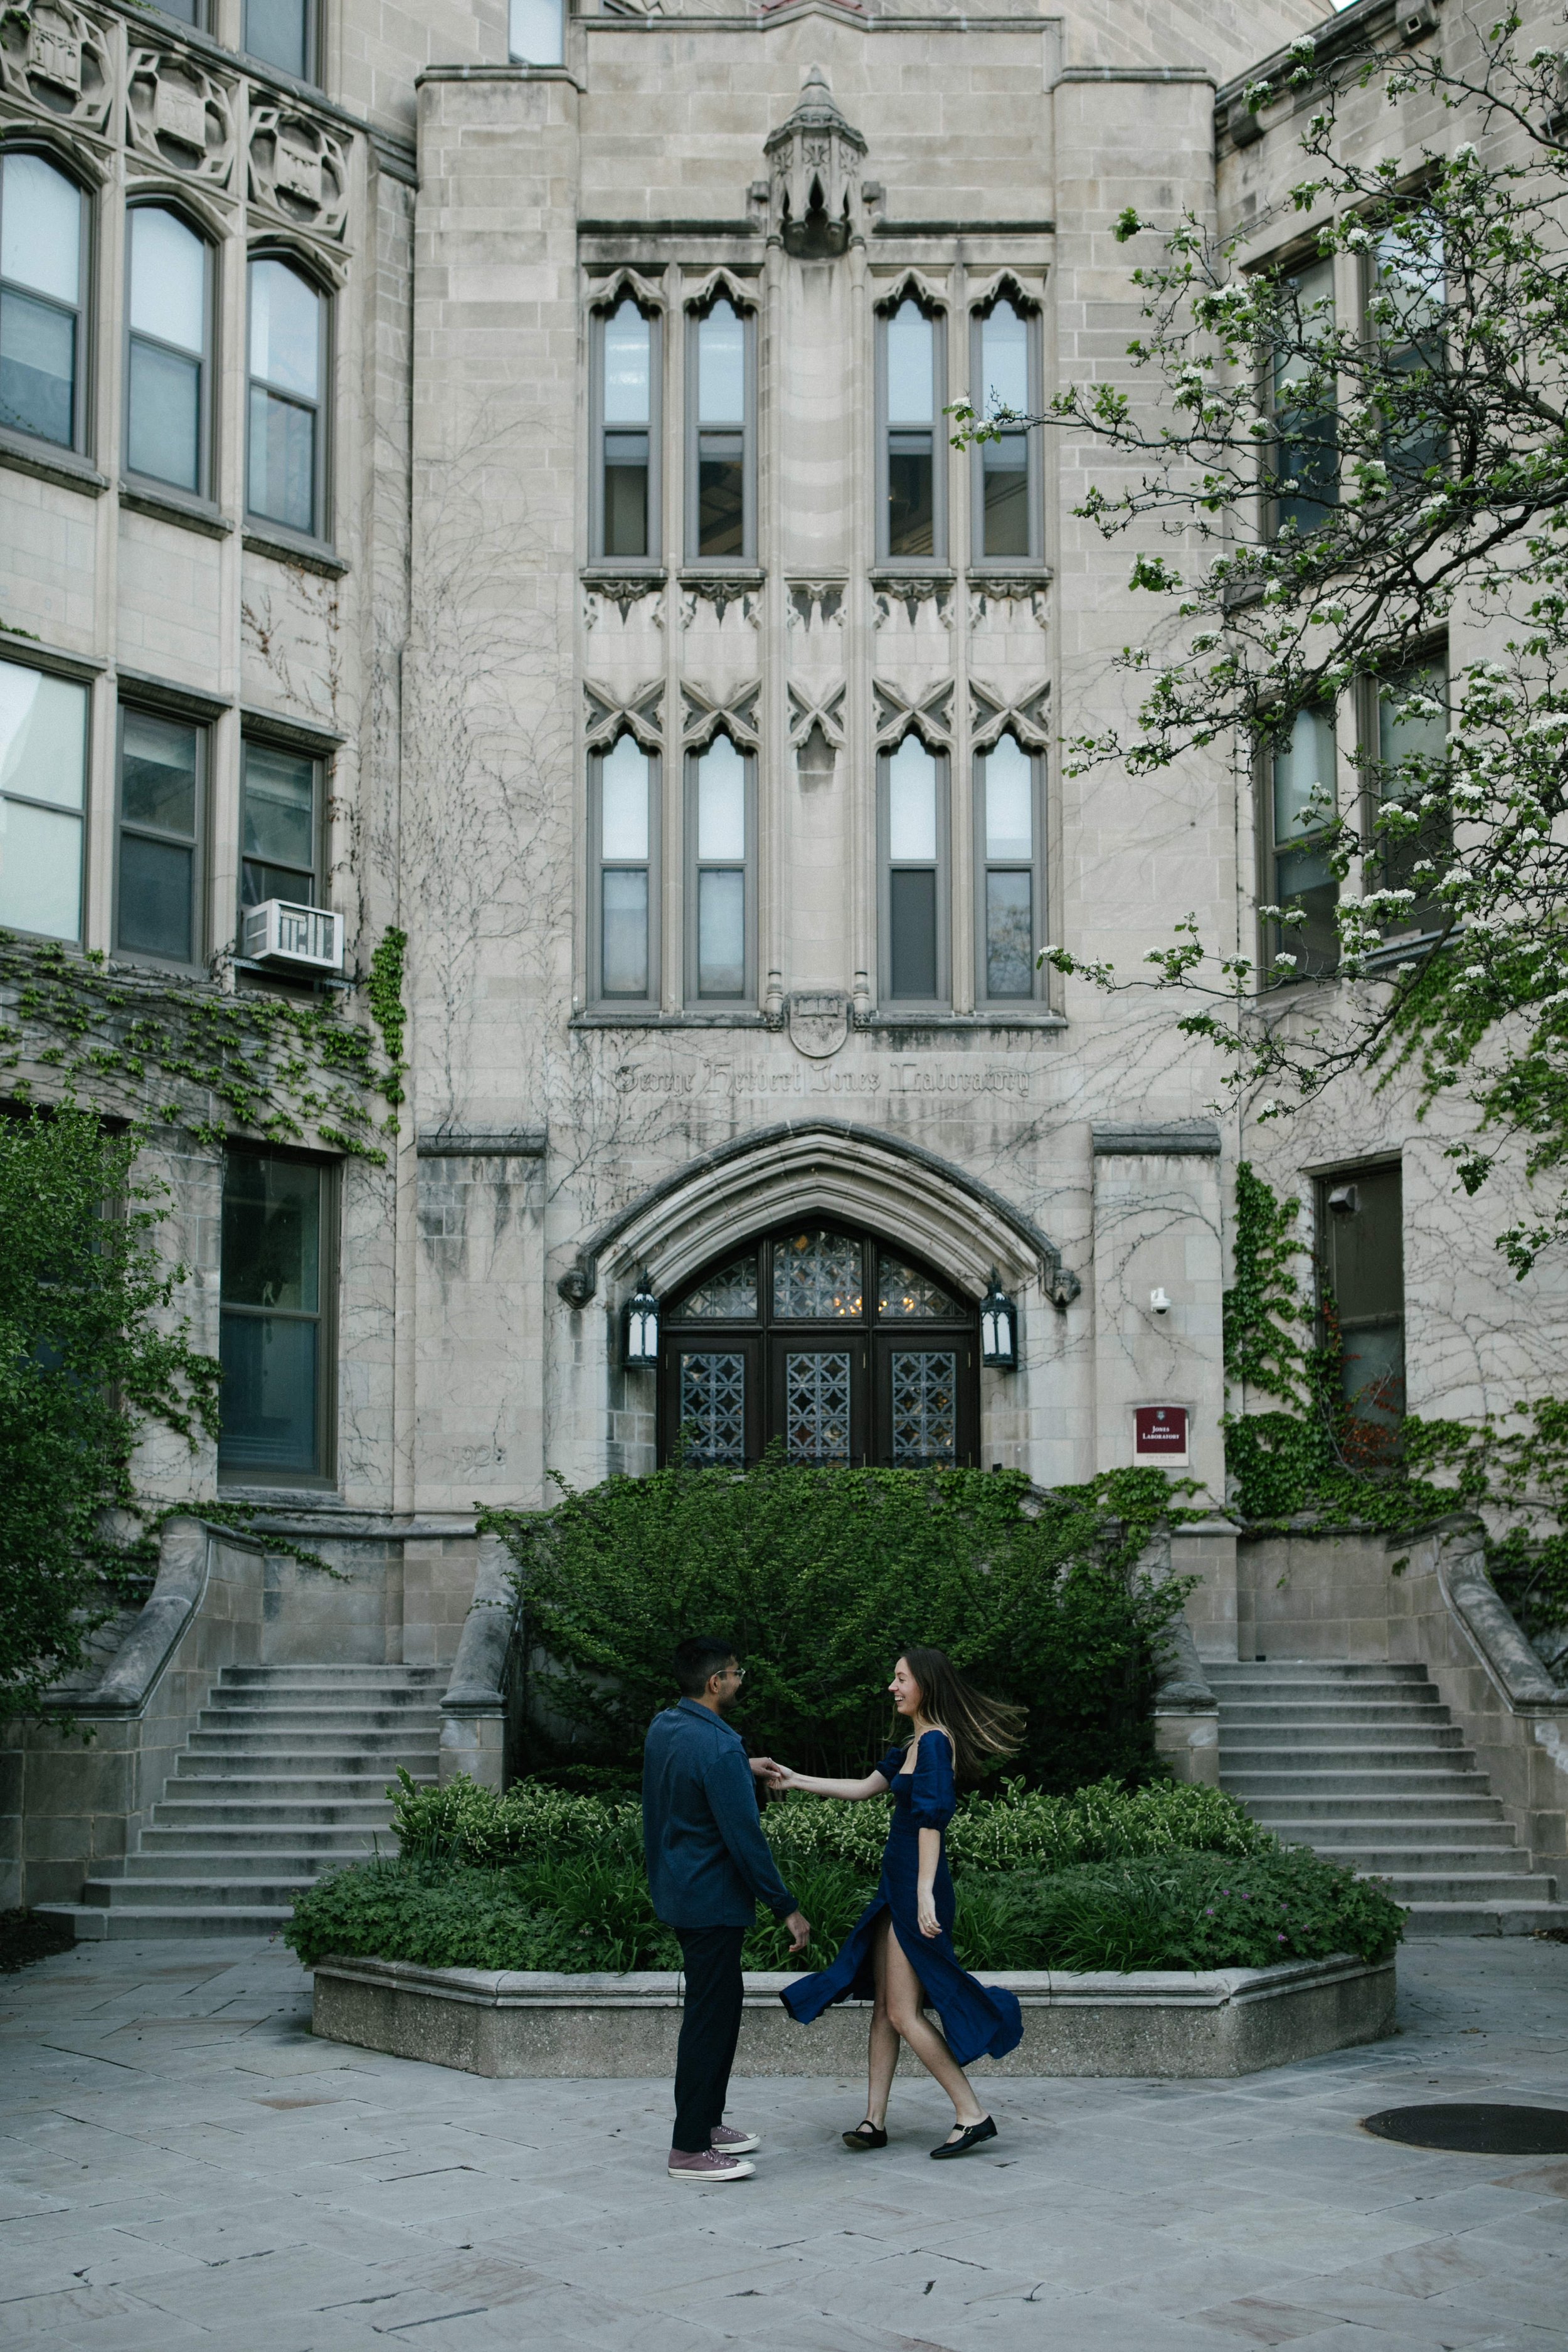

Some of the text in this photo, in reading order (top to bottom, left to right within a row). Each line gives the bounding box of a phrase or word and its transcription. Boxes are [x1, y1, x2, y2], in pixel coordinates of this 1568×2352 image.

[612, 1063, 1030, 1098] George Herbert Jones Laboratory
